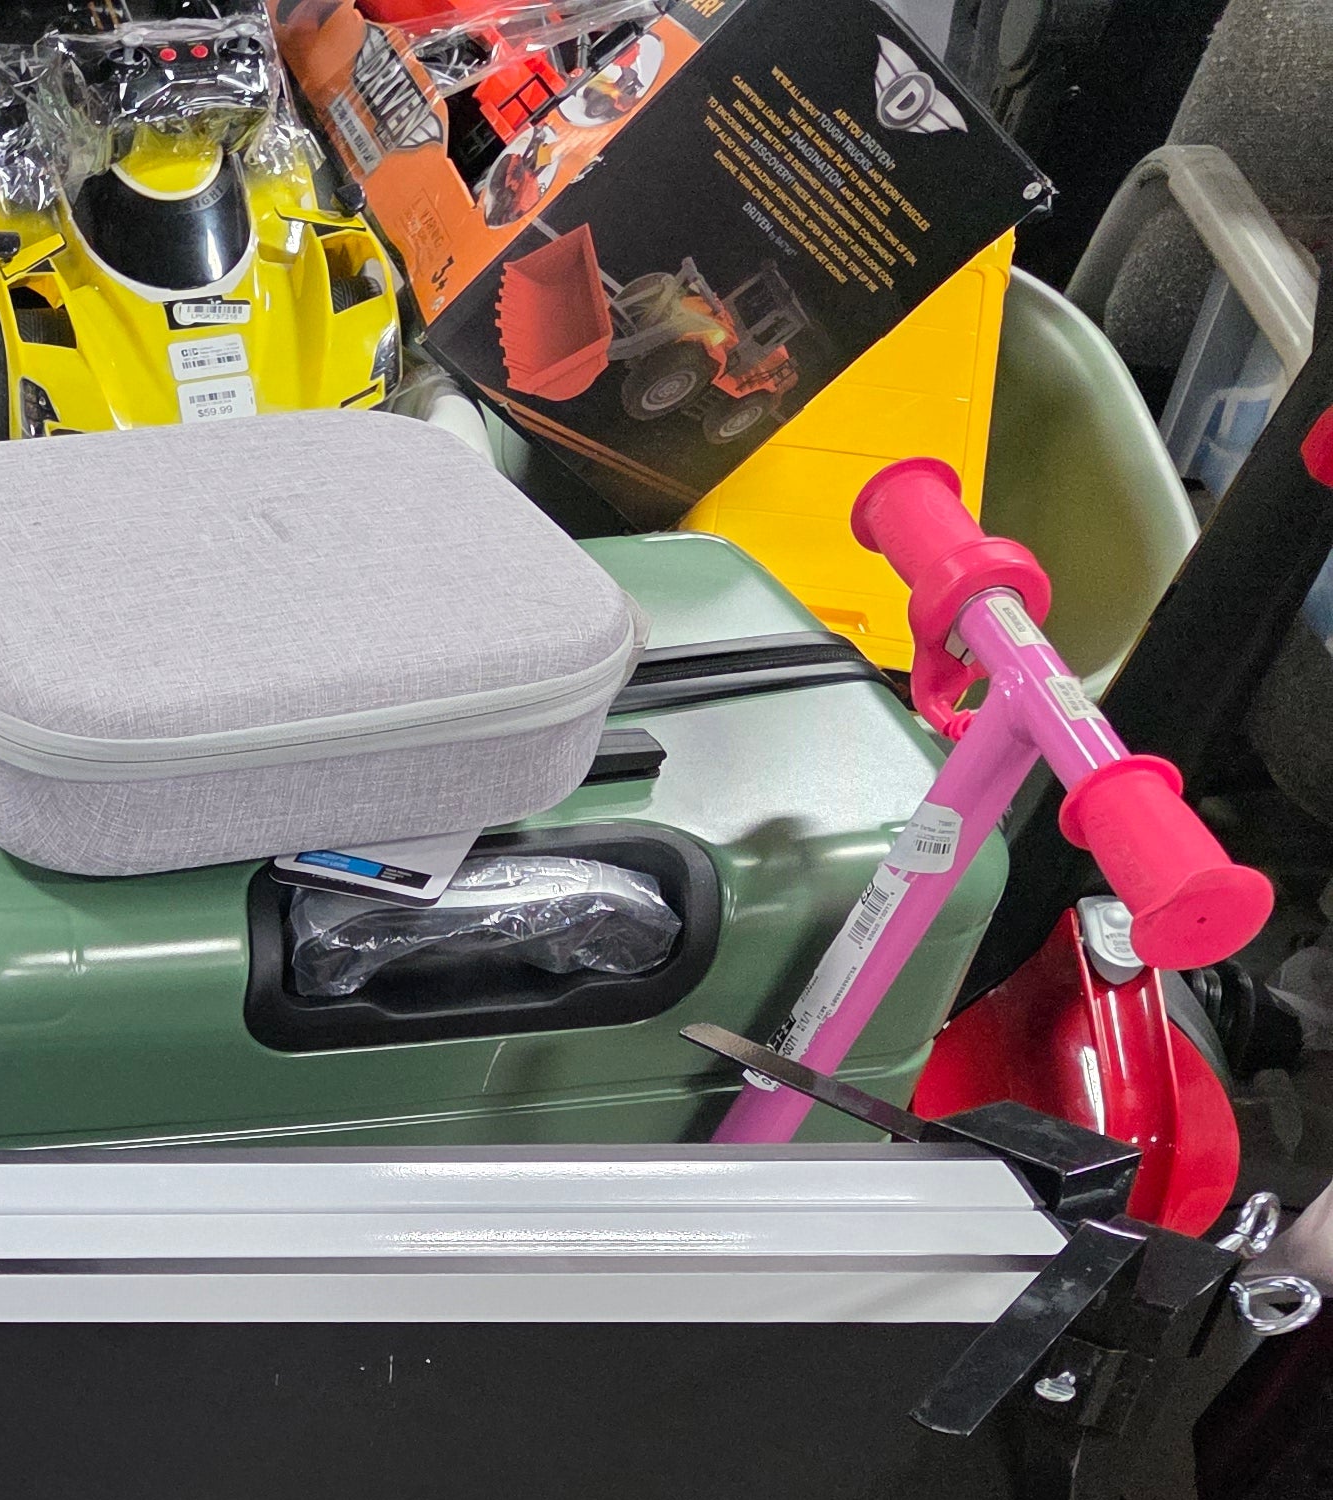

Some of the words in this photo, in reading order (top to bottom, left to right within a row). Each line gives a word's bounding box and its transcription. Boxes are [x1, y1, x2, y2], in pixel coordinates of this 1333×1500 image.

[356, 49, 427, 145] DRIVEN
[732, 97, 757, 126] DRIVEN
[703, 114, 721, 135] THEY
[716, 128, 736, 150] ALSO
[731, 73, 765, 110] CARRYING
[761, 104, 784, 130] LOADS
[788, 129, 845, 191] IMAGINATION
[839, 183, 855, 202] AND
[832, 105, 849, 125] ARE
[845, 118, 863, 140] YOU
[859, 131, 897, 173] DRIVEN?
[749, 136, 795, 187] DISCOVERY!
[798, 94, 821, 120] ABOUT
[817, 112, 845, 144] TOUGH
[841, 137, 873, 172] TRUCKS
[879, 178, 901, 203] WORK
[898, 197, 930, 233] VEHICLES
[832, 152, 852, 176] PLAY
[741, 199, 773, 234] DRIVEN
[197, 404, 233, 419] $59.99
